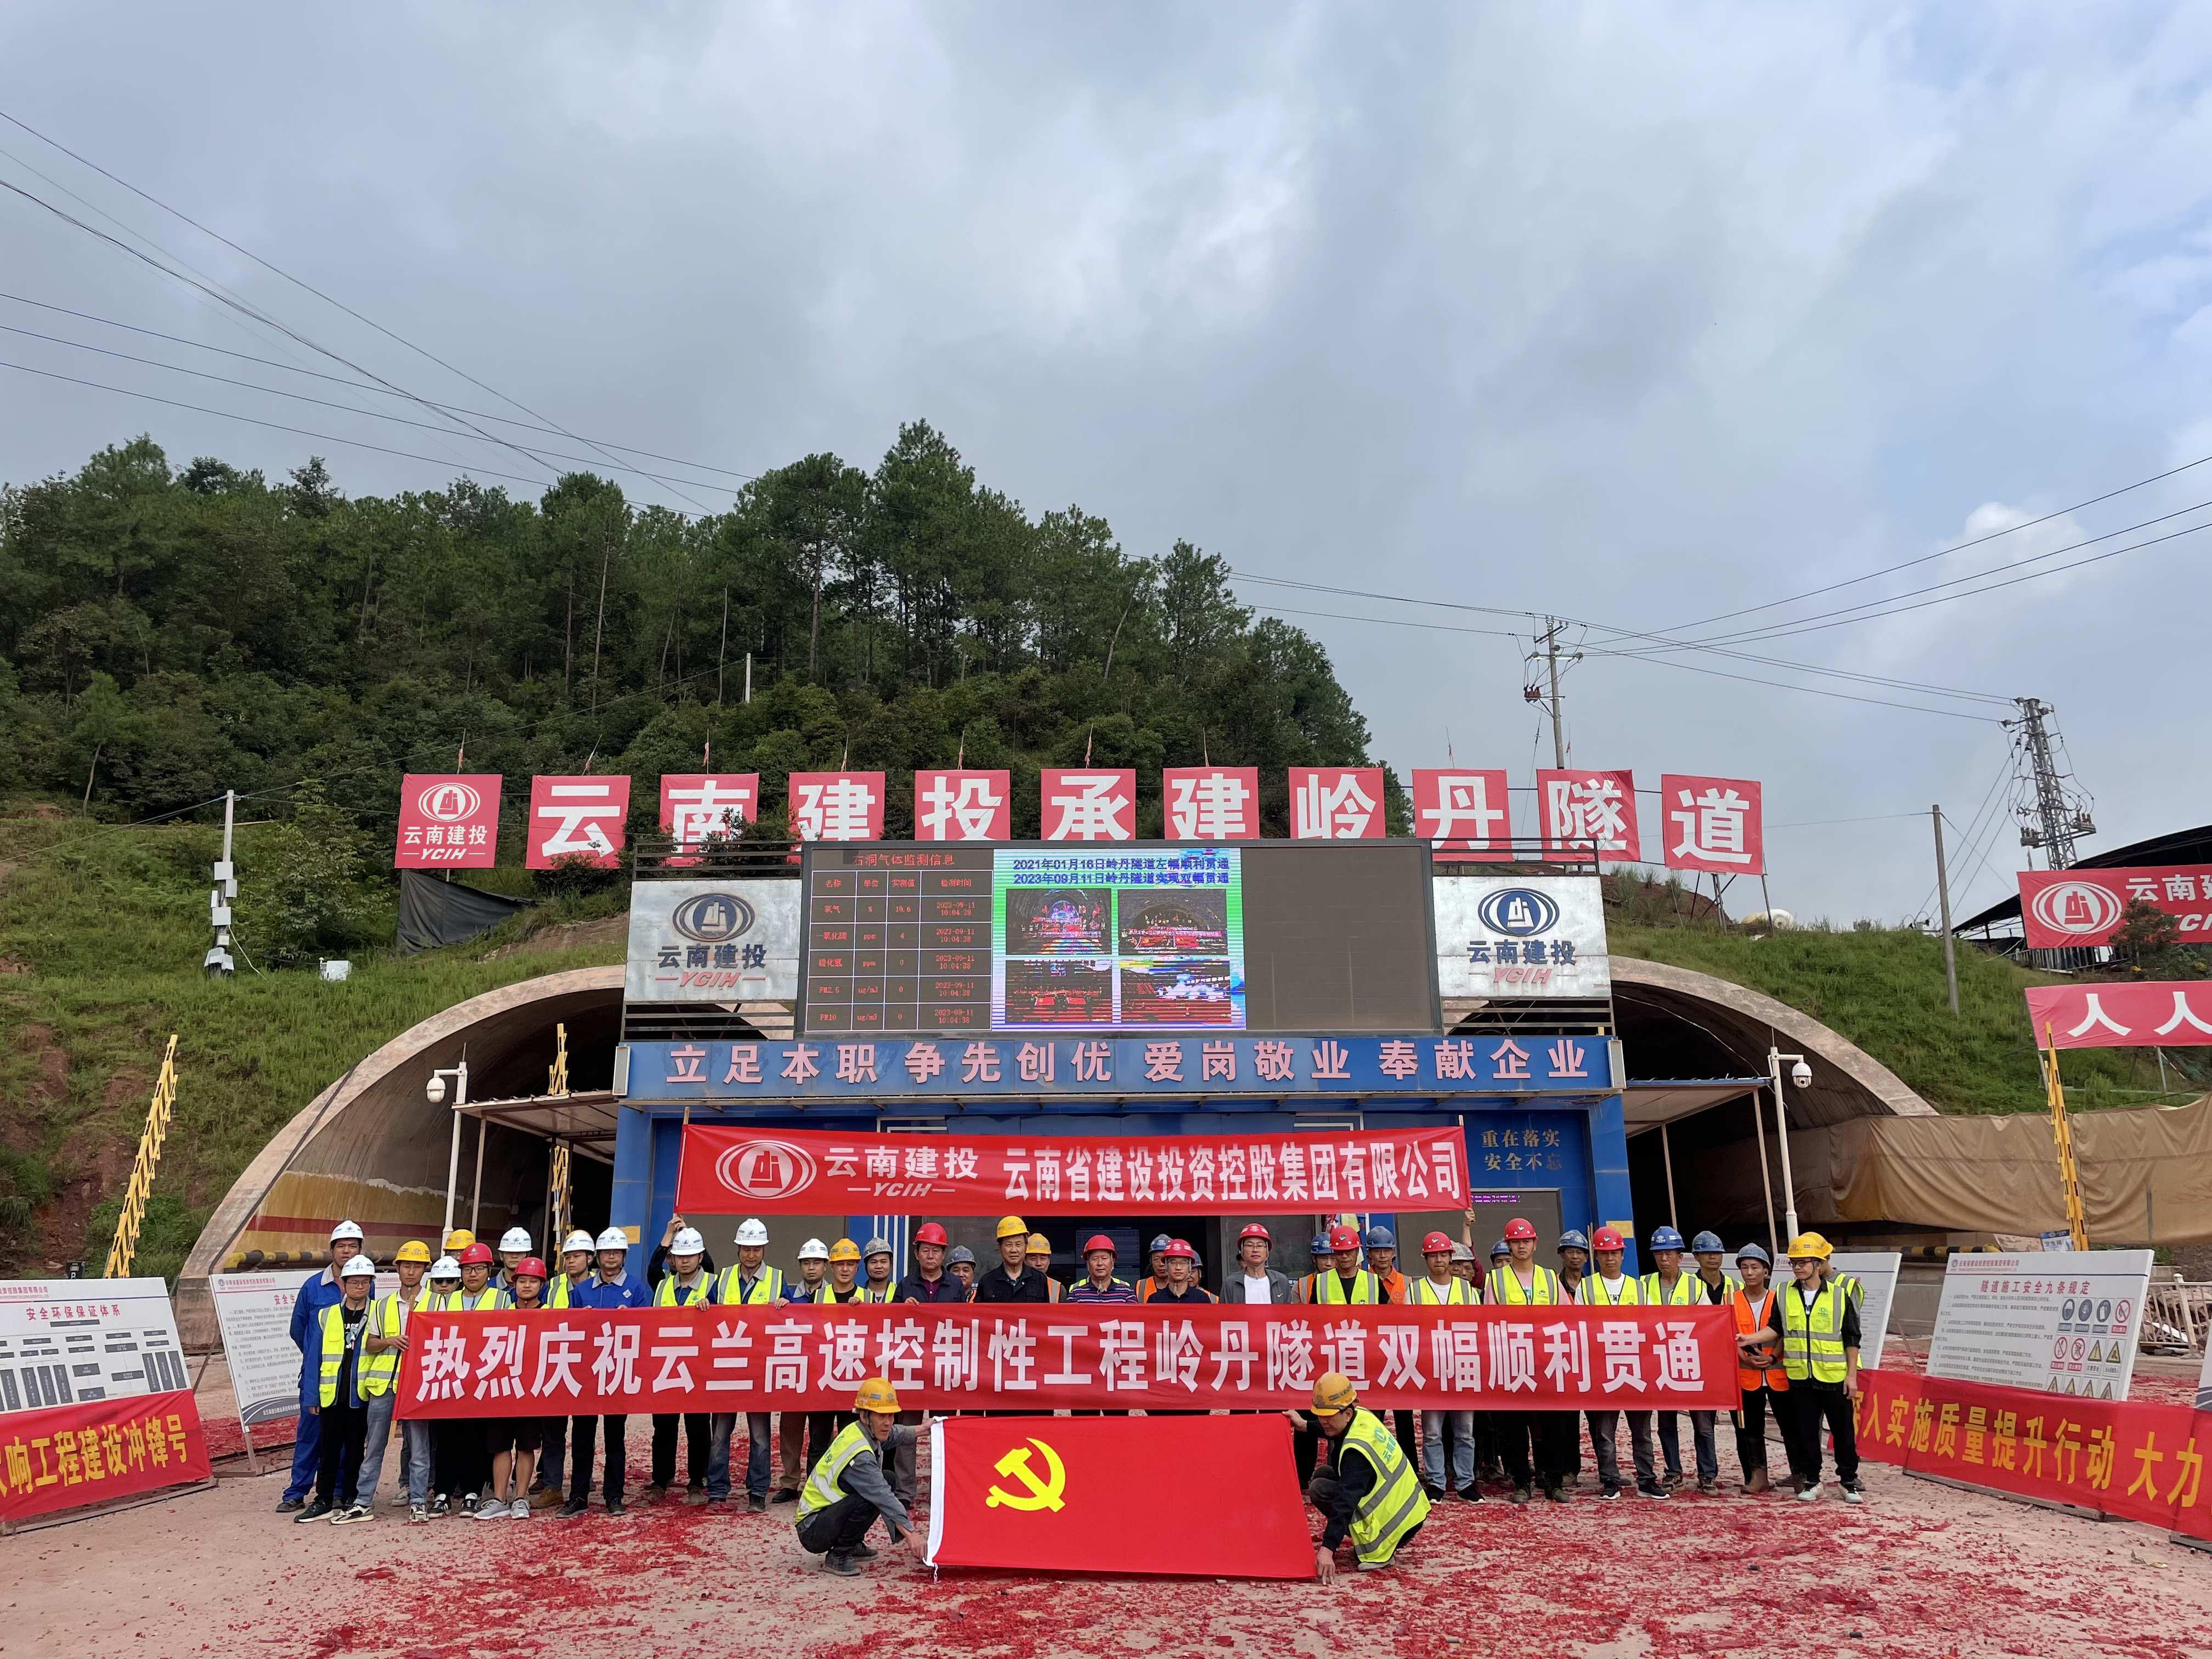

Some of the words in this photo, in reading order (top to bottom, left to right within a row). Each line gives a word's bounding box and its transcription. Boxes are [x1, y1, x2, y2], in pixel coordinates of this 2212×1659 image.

[404, 825, 488, 846] 云南建投
[419, 848, 466, 860] YCIH
[853, 854, 955, 867] 右洞气体监测信息
[825, 879, 842, 888] 名称
[864, 879, 879, 887] 单位
[891, 879, 915, 887] 实测值
[940, 878, 972, 887] 检测时间
[657, 943, 767, 969] 云南建投
[1466, 939, 1576, 966] 云南建投
[678, 972, 741, 988] YCIH
[1493, 968, 1553, 984] YCIH
[2067, 991, 2212, 1037] 人人
[667, 1043, 877, 1085] 立足本职
[904, 1041, 1112, 1084] 争先创优
[1143, 1040, 1351, 1082] 爱岗敬业
[1378, 1039, 1588, 1081] 奉献企业
[1481, 1129, 1560, 1148] 重在落实
[823, 1146, 979, 1180] 云南建投
[1485, 1153, 1562, 1171] 安全不忘
[1002, 1140, 1461, 1203] 云南省建设投资控股集团有限公司
[873, 1183, 933, 1197] YCIH
[1980, 1280, 2091, 1294] 隧道施工安全九条规定
[26, 1304, 120, 1321] 安全环保保证体系
[415, 1317, 1705, 1402] 热烈庆祝云兰高速控制性工程岭丹隧道双幅顺利贯通
[0, 1414, 187, 1498] 响工程建设冲锋号
